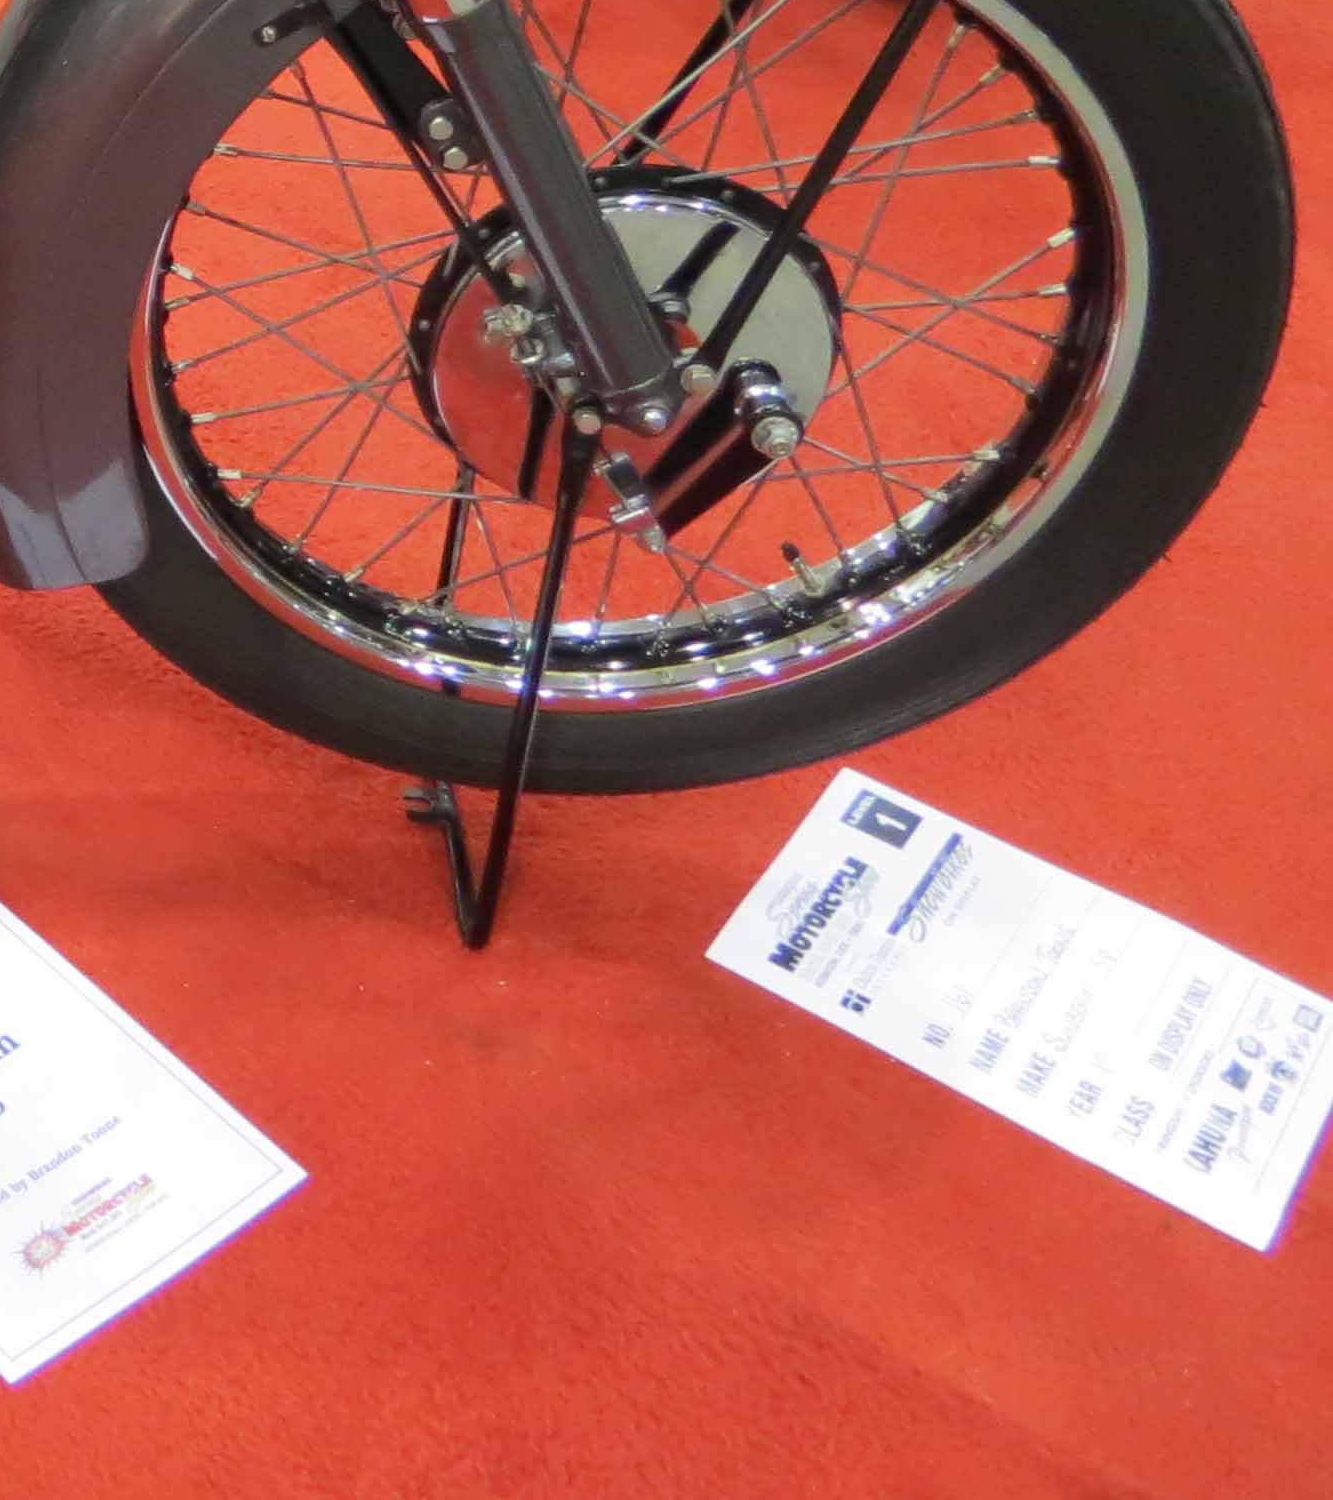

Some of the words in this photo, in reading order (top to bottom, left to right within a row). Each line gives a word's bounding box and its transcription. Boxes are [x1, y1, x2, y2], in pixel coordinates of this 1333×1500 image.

[767, 856, 871, 973] MOTORCYCLE
[968, 1027, 1010, 1076] NAME
[1016, 1052, 1057, 1098] MAKE
[7, 1178, 29, 1198] by
